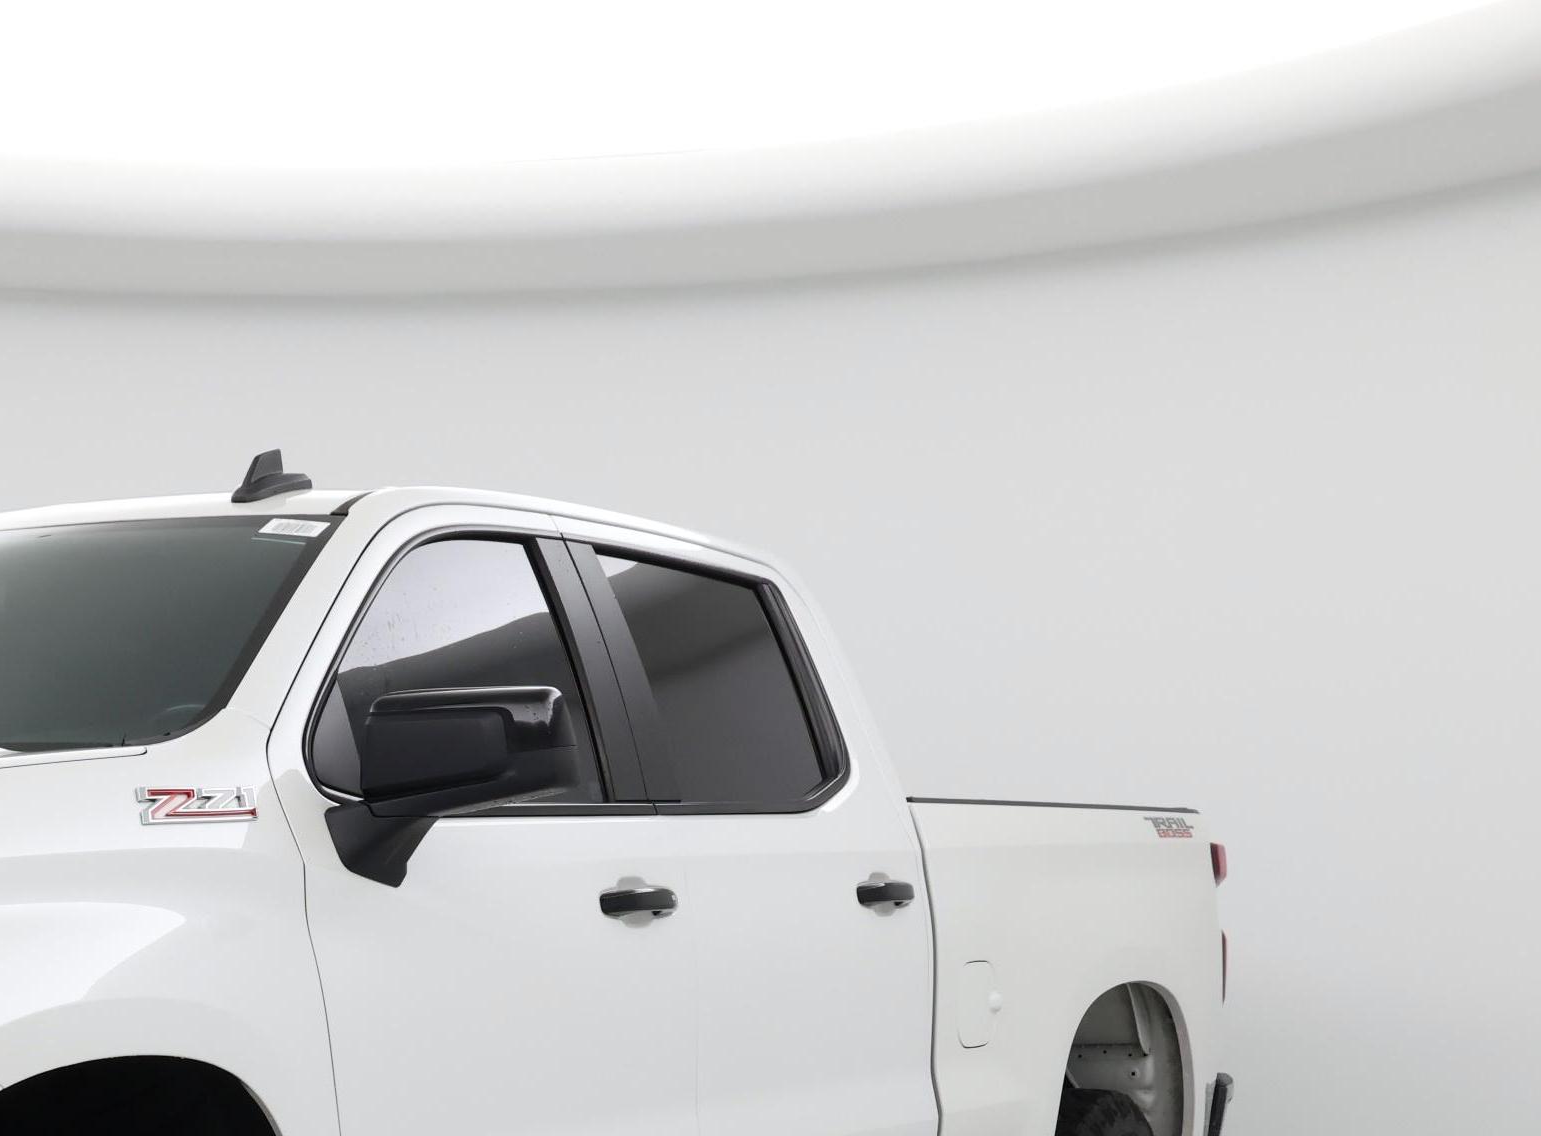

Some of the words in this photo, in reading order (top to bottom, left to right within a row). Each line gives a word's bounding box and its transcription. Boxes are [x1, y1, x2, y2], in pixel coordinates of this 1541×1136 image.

[136, 786, 258, 824] Z71
[1144, 816, 1194, 829] TRAIL
[1156, 828, 1193, 838] BOSS
